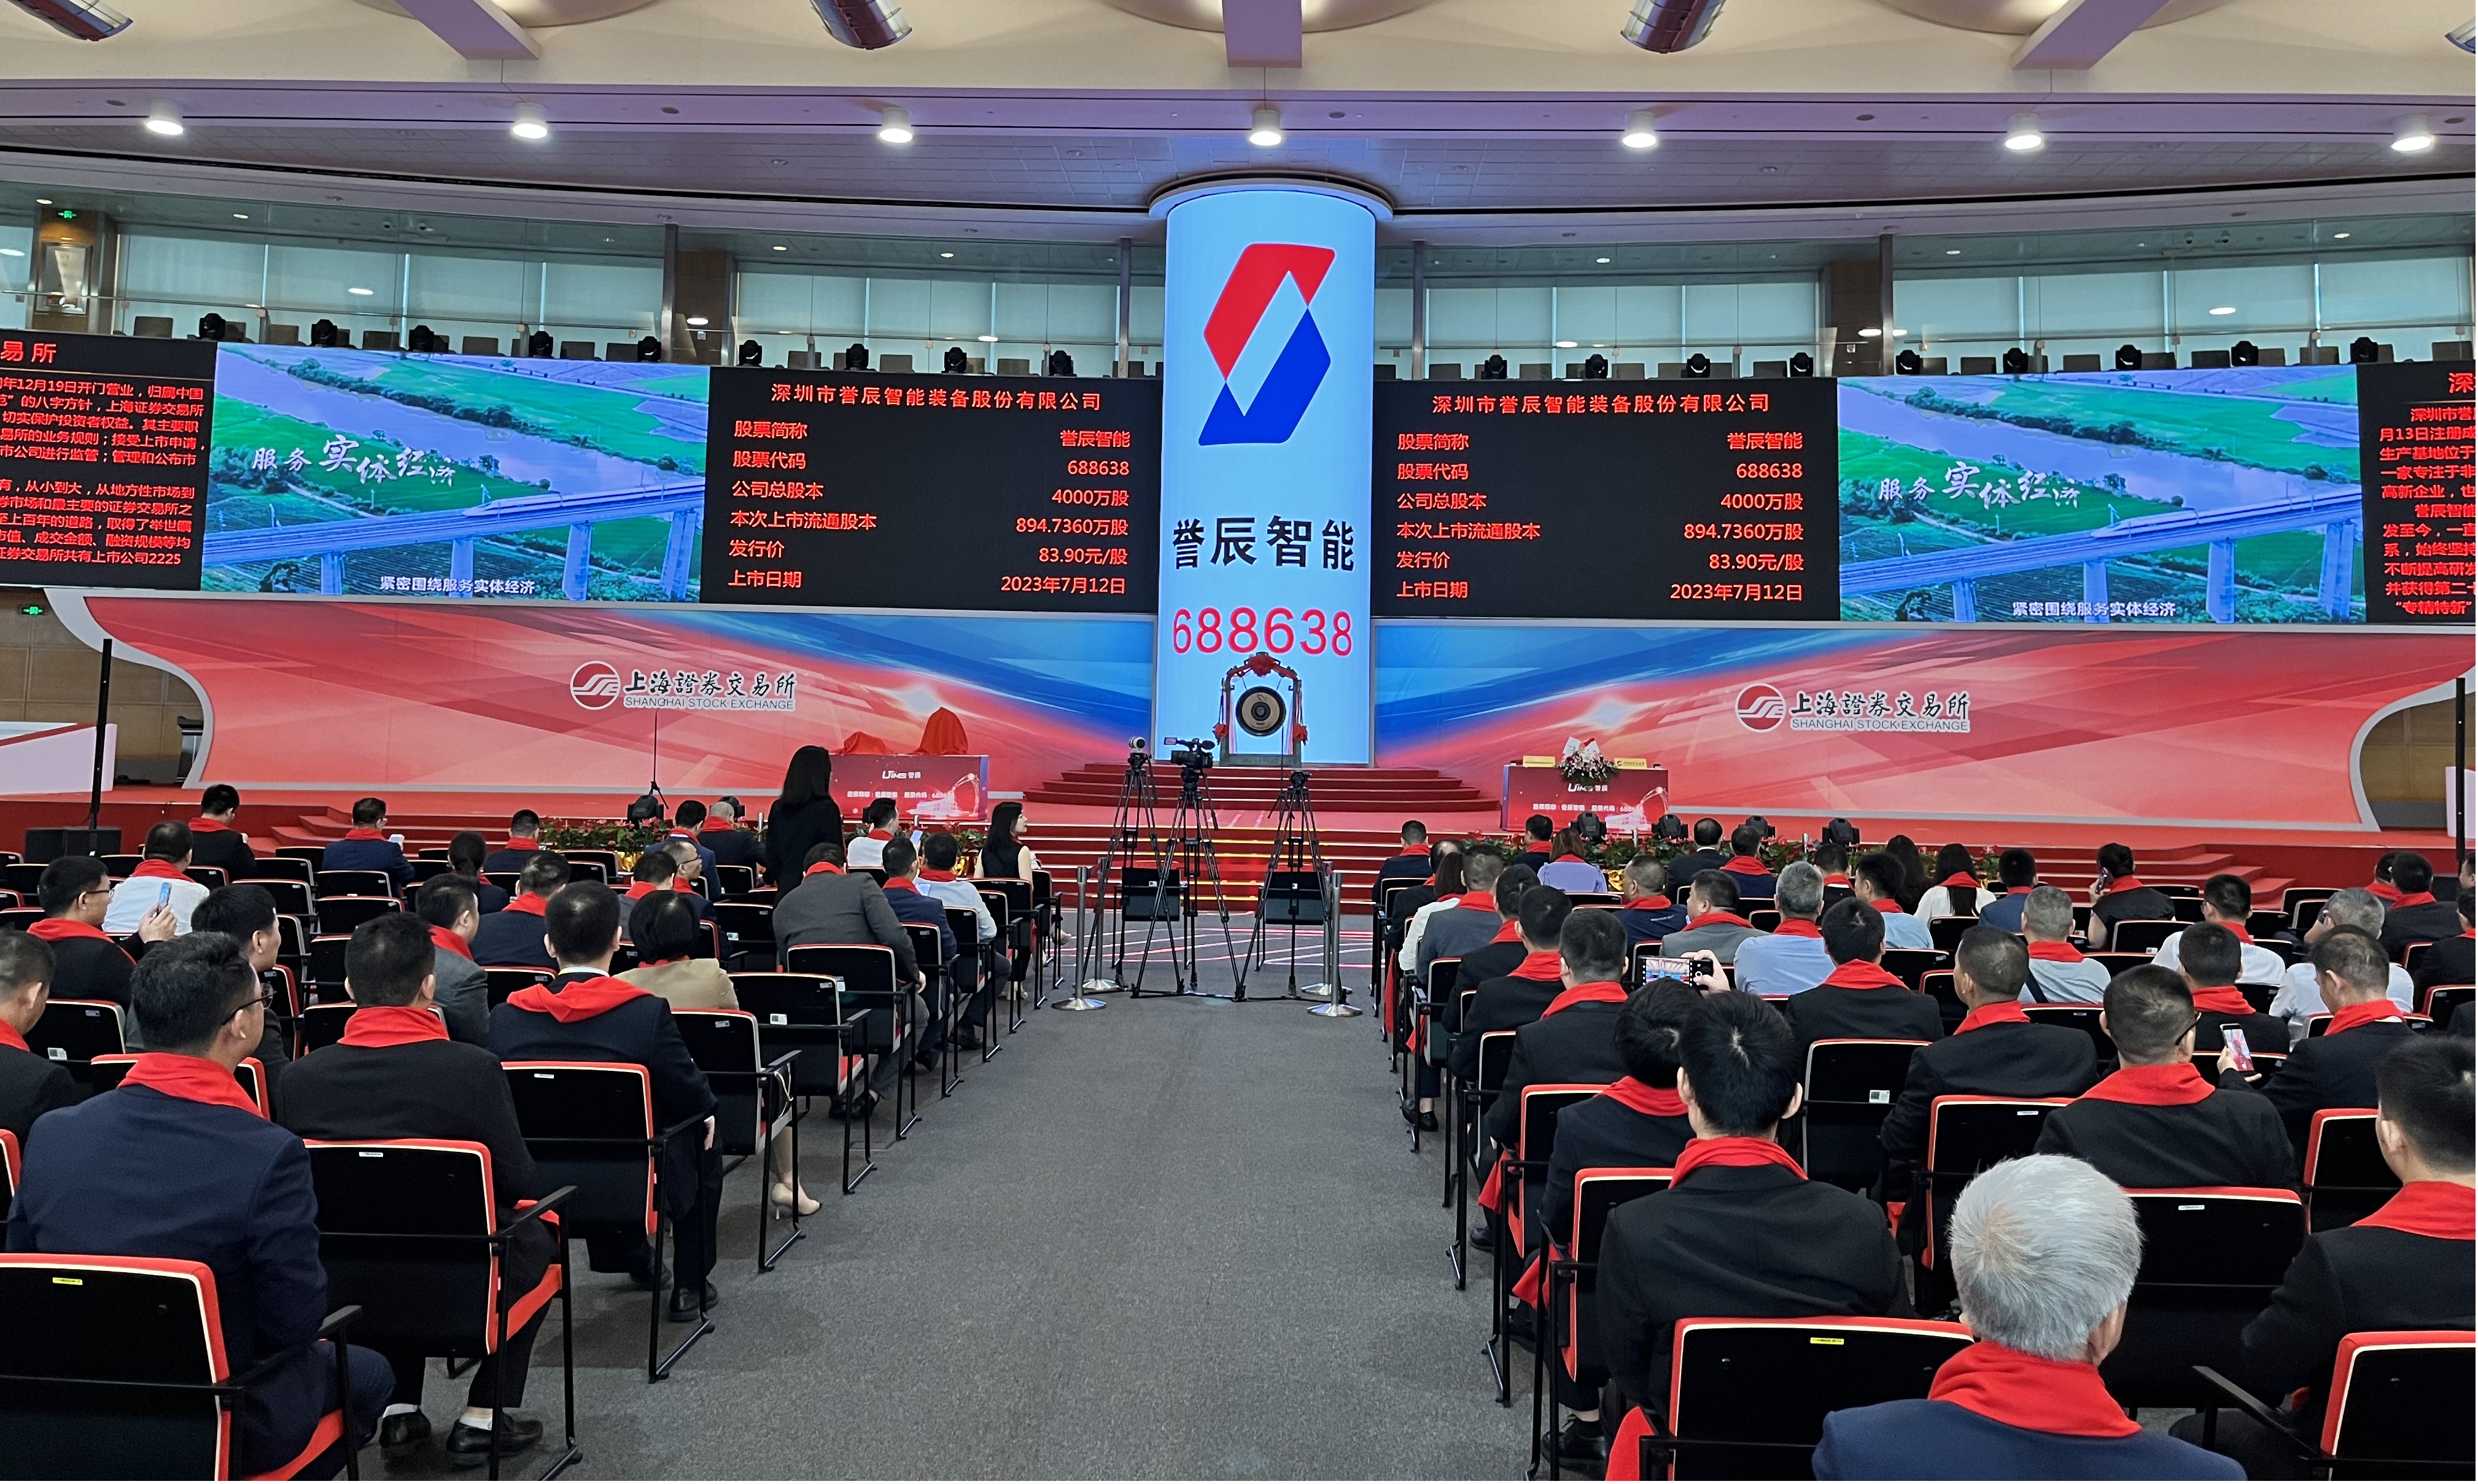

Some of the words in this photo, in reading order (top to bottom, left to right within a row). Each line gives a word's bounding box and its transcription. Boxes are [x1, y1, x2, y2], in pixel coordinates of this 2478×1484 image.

[0, 341, 56, 363] 易所
[0, 376, 203, 400] 年12月19日开门营业，归属中国
[771, 383, 1100, 411] 深圳市誉辰智能装备股份有限公司
[1432, 393, 1768, 414] 深圳市誉辰智能装备股份有限公司
[2410, 406, 2476, 422] 深圳市誉
[734, 420, 808, 440] 股票简称
[1060, 429, 1130, 448] 誉辰智能
[1397, 433, 1469, 451] 股票简称
[1727, 431, 1803, 450] 誉辰智能
[252, 434, 456, 487] 服务实体经济
[732, 451, 806, 470] 股票代码
[1068, 460, 1130, 475] 688638
[1397, 463, 1469, 481] 股票代码
[1736, 463, 1803, 478] 688638
[732, 480, 824, 500] 公司总股本
[1051, 489, 1130, 507] 4000万股
[1879, 460, 2080, 508] 服务实体经济
[1397, 492, 1487, 510] 公司总股本
[1720, 492, 1803, 511] 4000万股
[2415, 503, 2476, 518] 誉辰智能
[730, 510, 877, 530] 本次上市流通股本
[1016, 518, 1128, 536] 894.7360万股
[1396, 521, 1540, 540] 本次上市流通股本
[1684, 523, 1804, 541] 894.7360万股
[729, 539, 785, 558] 发行价
[1039, 548, 1128, 565] 83.90元/股
[1173, 515, 1354, 571] 誉辰智能
[1396, 551, 1450, 569] 发行价
[1709, 554, 1804, 572] 83.90元/股
[379, 576, 535, 594] 紧密围绕服务实体经济
[728, 569, 802, 588] 上市日期
[1001, 576, 1125, 594] 2023年7月12日
[1396, 581, 1468, 599] 上市日期
[1670, 583, 1802, 601] 2023年7月12日
[2013, 602, 2177, 616] 紧密围绕服务实体经济
[1173, 607, 1352, 656] 688638
[624, 670, 795, 699] 上海證券交易所
[625, 697, 685, 707] SHANGHAI
[688, 698, 727, 708] STOCK
[731, 699, 794, 710] EXCHANGE
[1791, 692, 1970, 720] 上海證券交易所
[1792, 718, 1854, 729] SHANGHAI
[1857, 719, 1898, 729] STOCK
[1901, 720, 1968, 731] EXCHANGE
